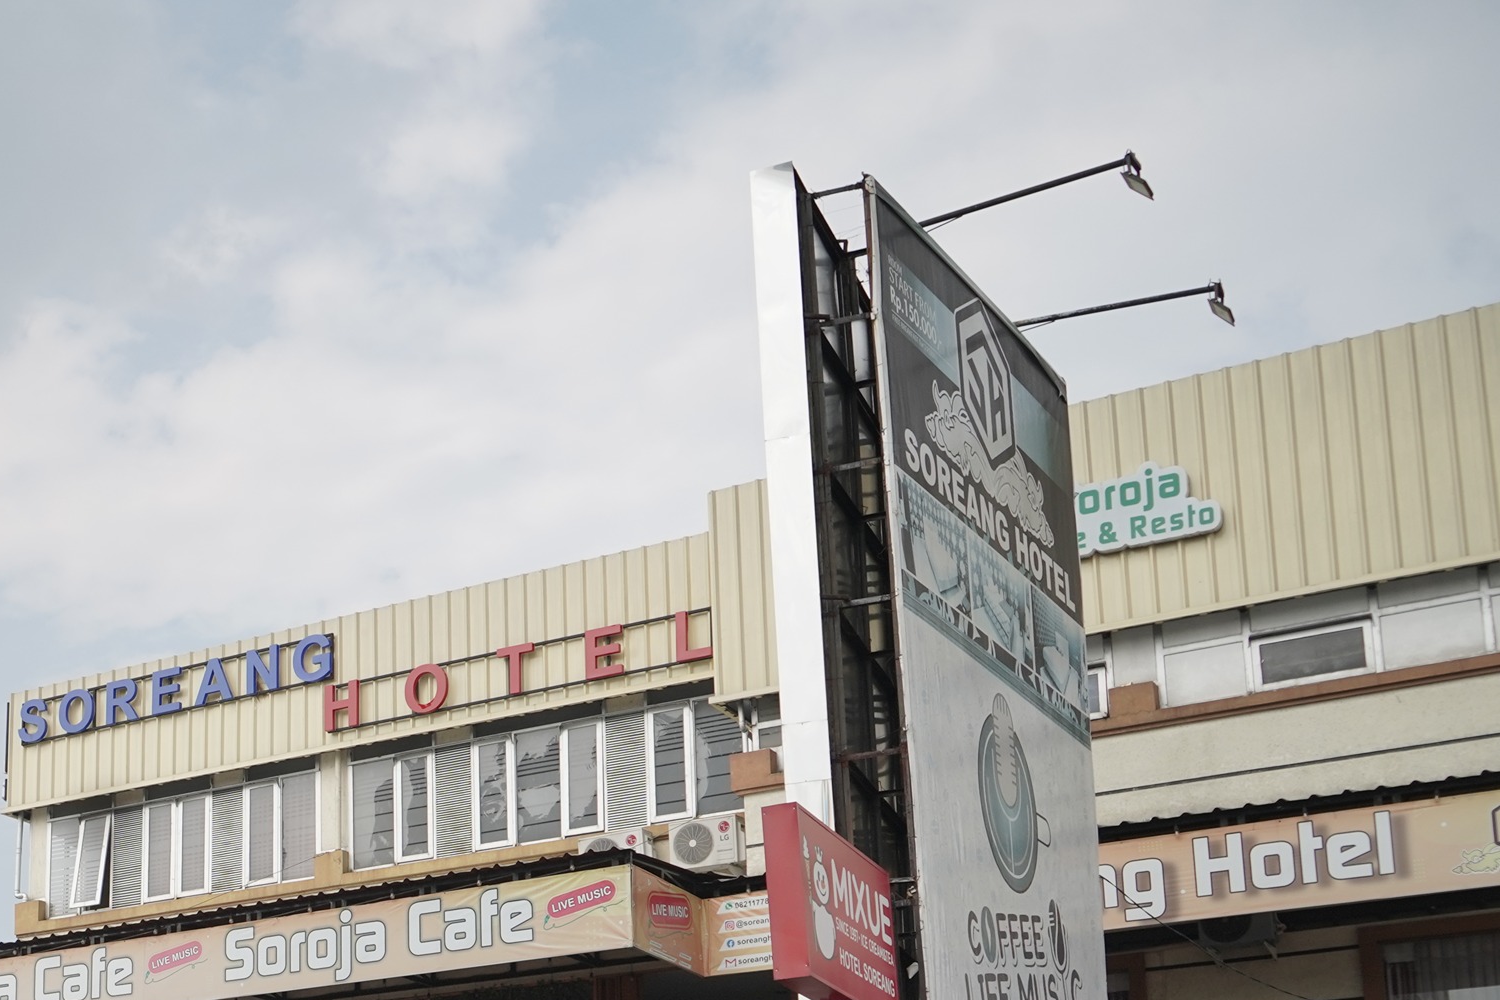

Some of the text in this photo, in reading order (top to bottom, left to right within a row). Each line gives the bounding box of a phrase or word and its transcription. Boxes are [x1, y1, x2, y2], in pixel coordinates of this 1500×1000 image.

[889, 266, 913, 302] START
[1078, 468, 1180, 515] oroja
[904, 428, 1076, 612] SOREANG HOTEL
[1099, 521, 1118, 544] &
[1130, 504, 1215, 540] Resto
[17, 632, 334, 744] SOREANG
[323, 609, 713, 734] HOTEL
[719, 834, 730, 842] LG
[1192, 810, 1396, 898] Hotel
[551, 884, 613, 913] LIVE MUSIC
[651, 903, 689, 918] LIVE MUSIC
[831, 858, 893, 947] MIXUE
[224, 888, 535, 982] Soroja Cafe
[835, 917, 850, 937] SINCE
[967, 906, 1047, 968] COFFEE
[151, 946, 199, 969] LIVE MUSIC
[839, 947, 895, 998] HOTEL SOREANG
